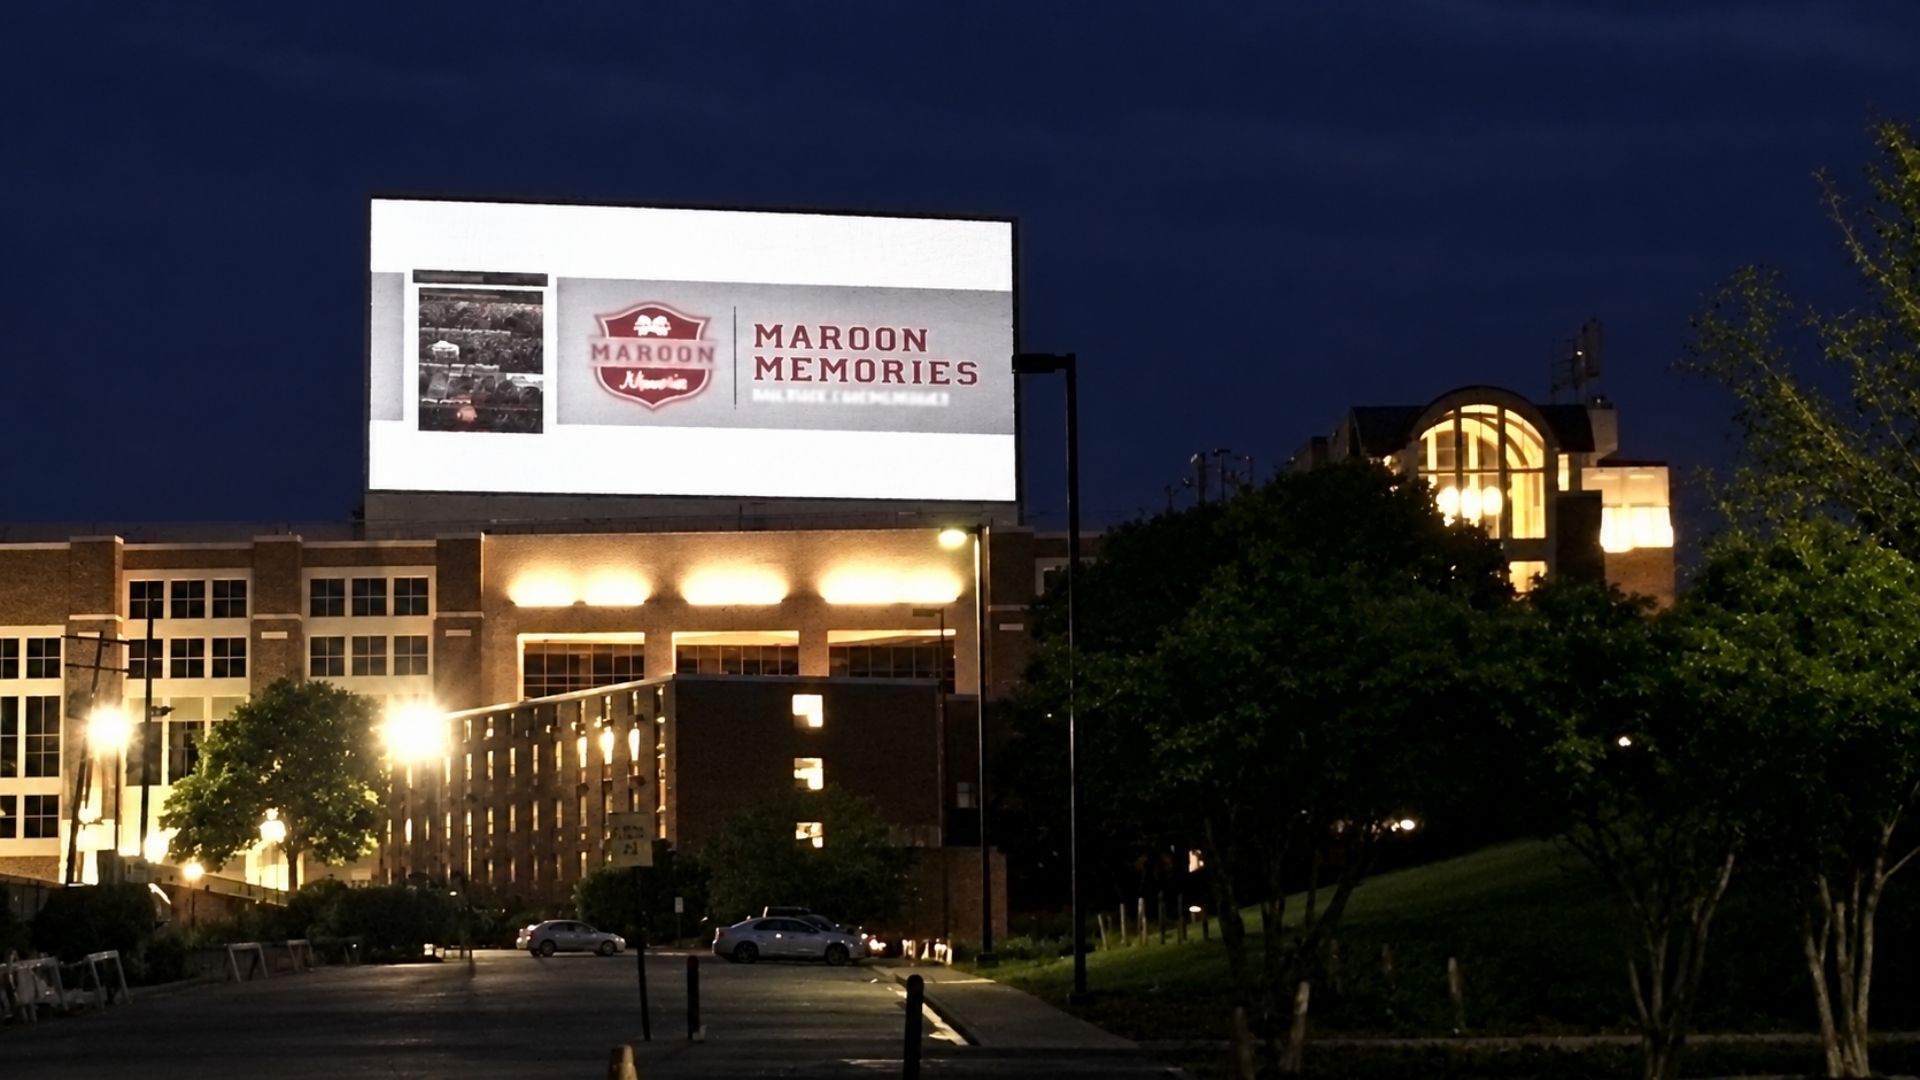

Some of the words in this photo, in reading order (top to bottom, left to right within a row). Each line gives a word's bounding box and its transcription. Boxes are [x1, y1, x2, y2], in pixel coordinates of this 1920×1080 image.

[754, 323, 928, 352] MAROON
[591, 343, 714, 363] MAROON
[754, 356, 978, 386] MEMORIES
